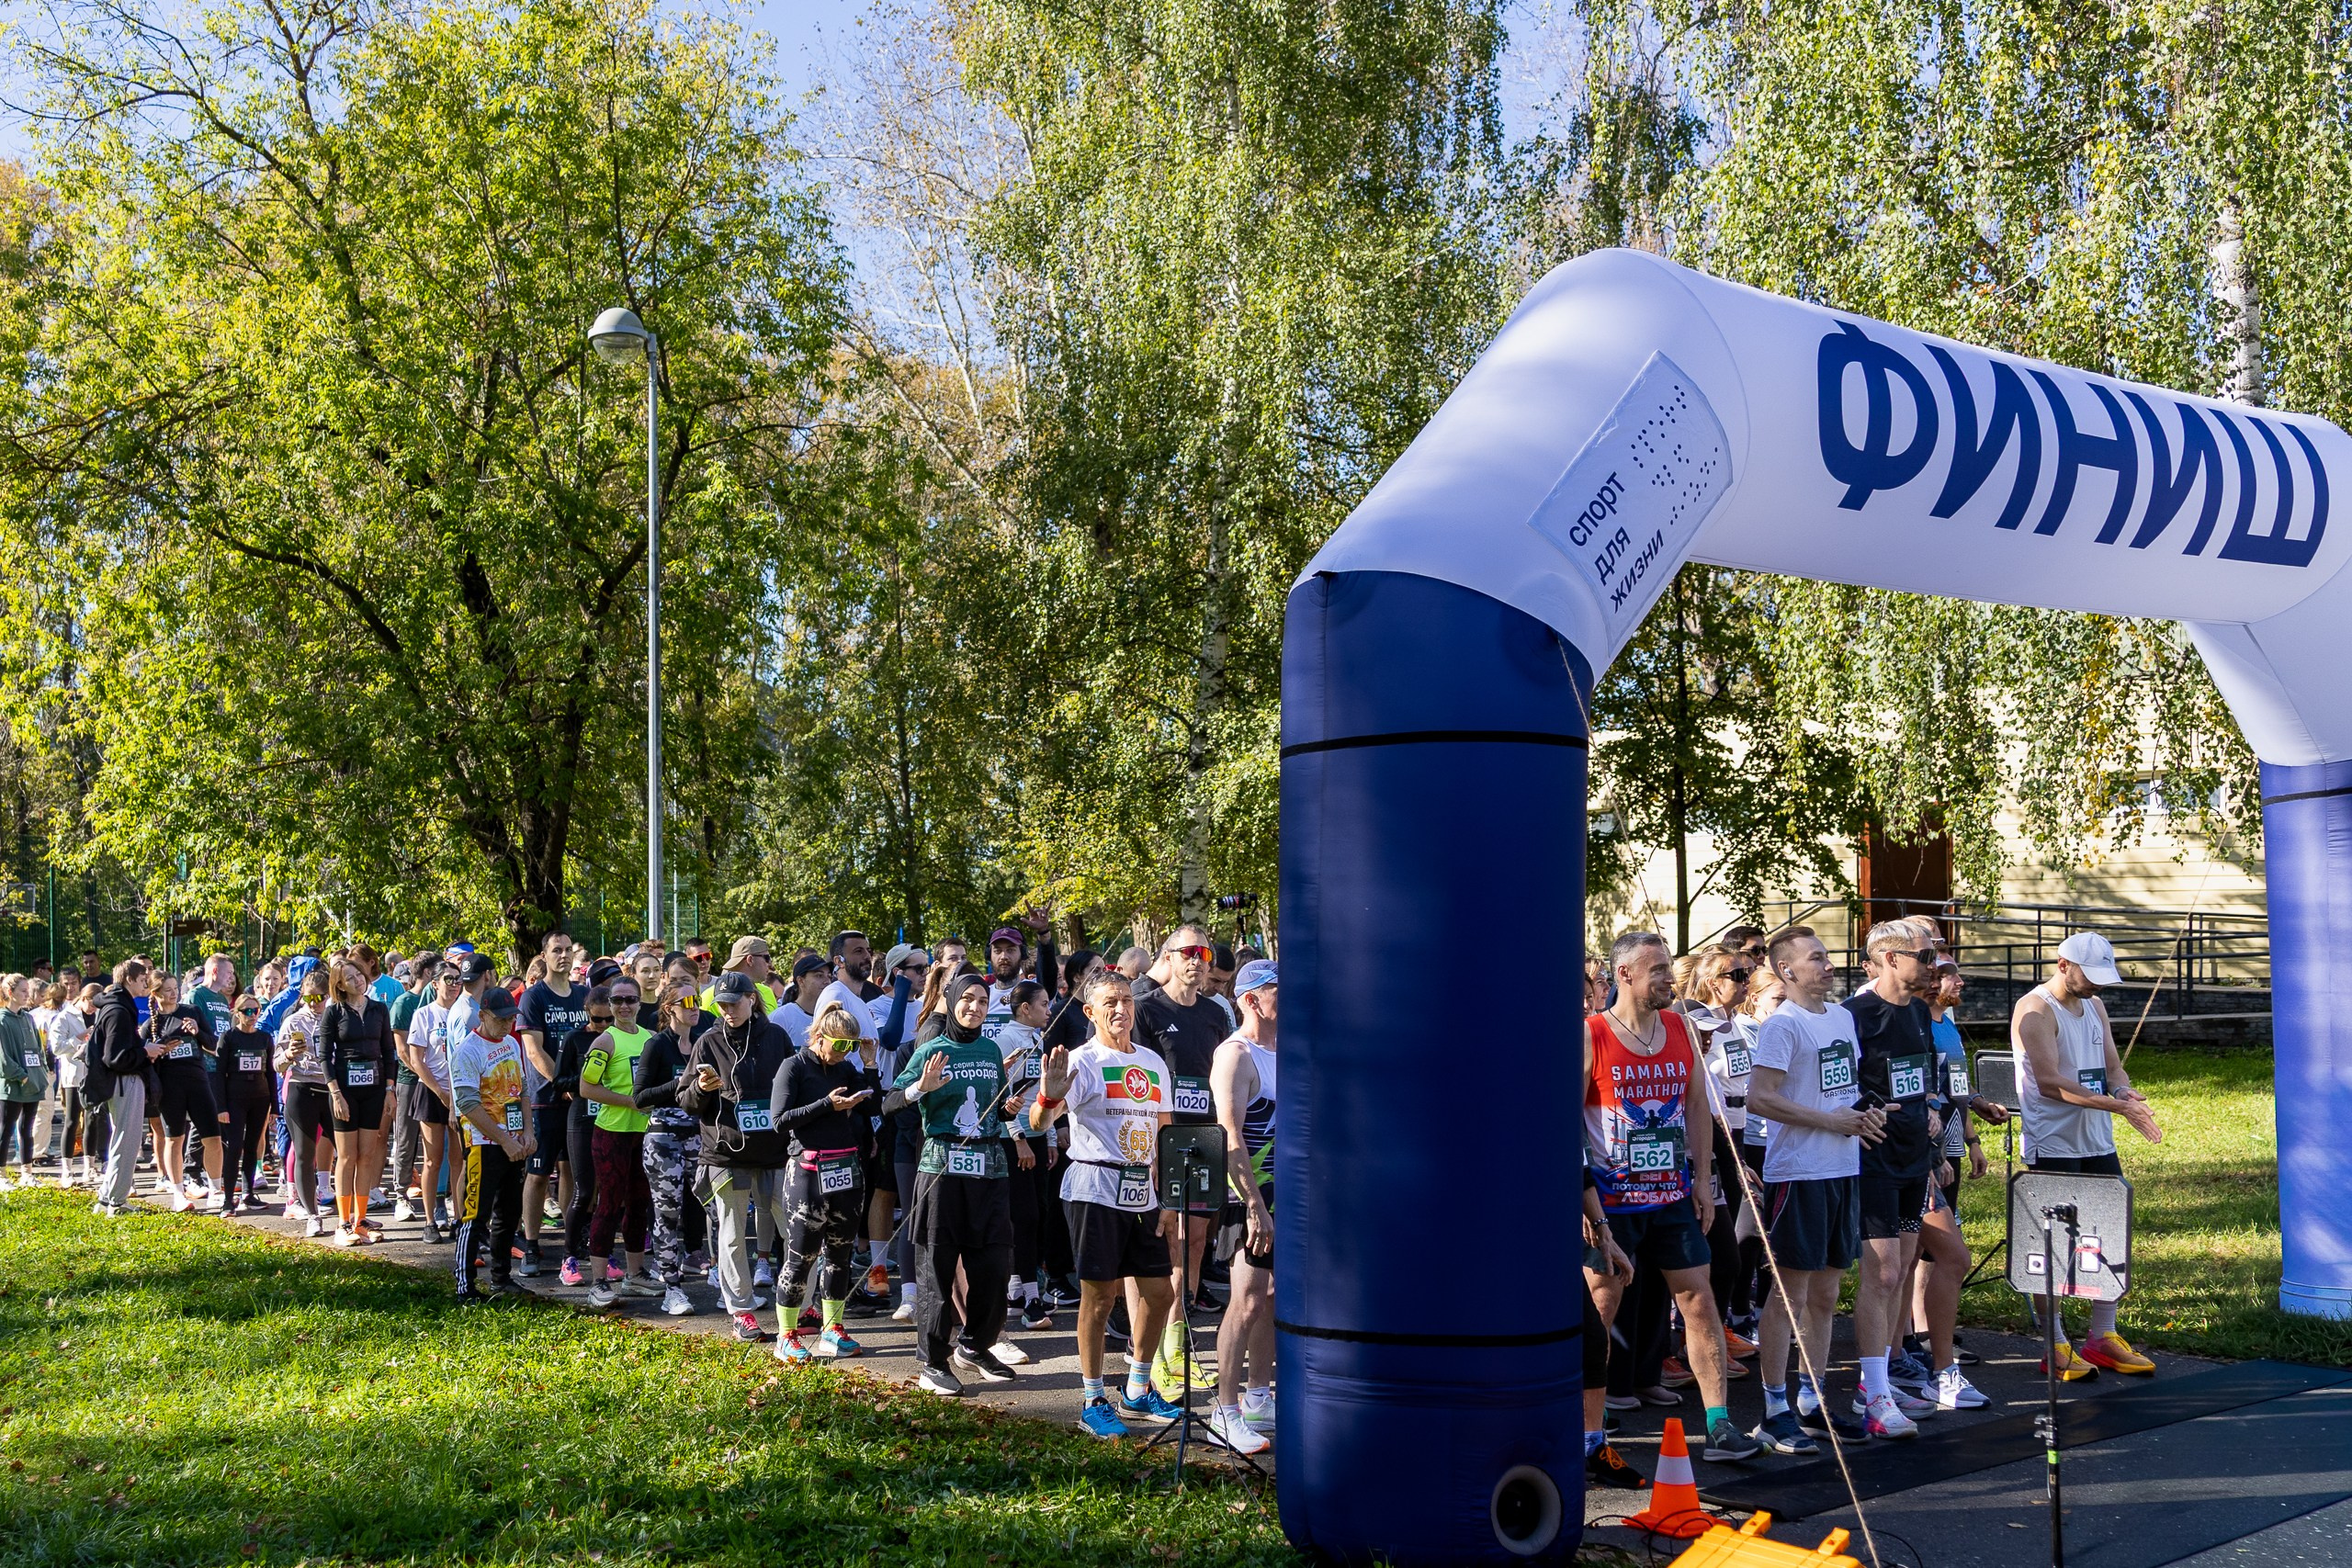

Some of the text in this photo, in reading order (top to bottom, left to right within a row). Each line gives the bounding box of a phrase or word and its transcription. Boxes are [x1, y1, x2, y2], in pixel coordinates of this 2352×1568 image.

[1817, 320, 2330, 567] ФИНИШ
[1594, 526, 1631, 586] для
[1610, 528, 1664, 614] жизни
[545, 1010, 589, 1024] CAMP DAVI
[170, 1046, 191, 1057] 598
[243, 1060, 260, 1069] 517
[953, 1061, 974, 1069] серия
[1026, 1063, 1040, 1077] 55
[1611, 1061, 1688, 1081] SAMARA
[1731, 1056, 1749, 1074] 555
[349, 1073, 373, 1084] 1066
[941, 1065, 999, 1081] 5 городов
[1824, 1065, 1849, 1087] 559
[1613, 1082, 1686, 1100] MARATHON
[1895, 1075, 1920, 1095] 516
[1952, 1078, 1967, 1093] 614
[1175, 1095, 1208, 1110] 1020
[1105, 1108, 1133, 1116] ВЕТЕРАНЫ
[742, 1114, 769, 1129] 610
[1129, 1129, 1148, 1151] 65
[953, 1156, 981, 1173] 581
[1634, 1148, 1671, 1168] 562
[822, 1173, 852, 1190] 1055
[1611, 1181, 1677, 1191] ПОТОМУ ЧТО
[1122, 1187, 1148, 1202] 1067
